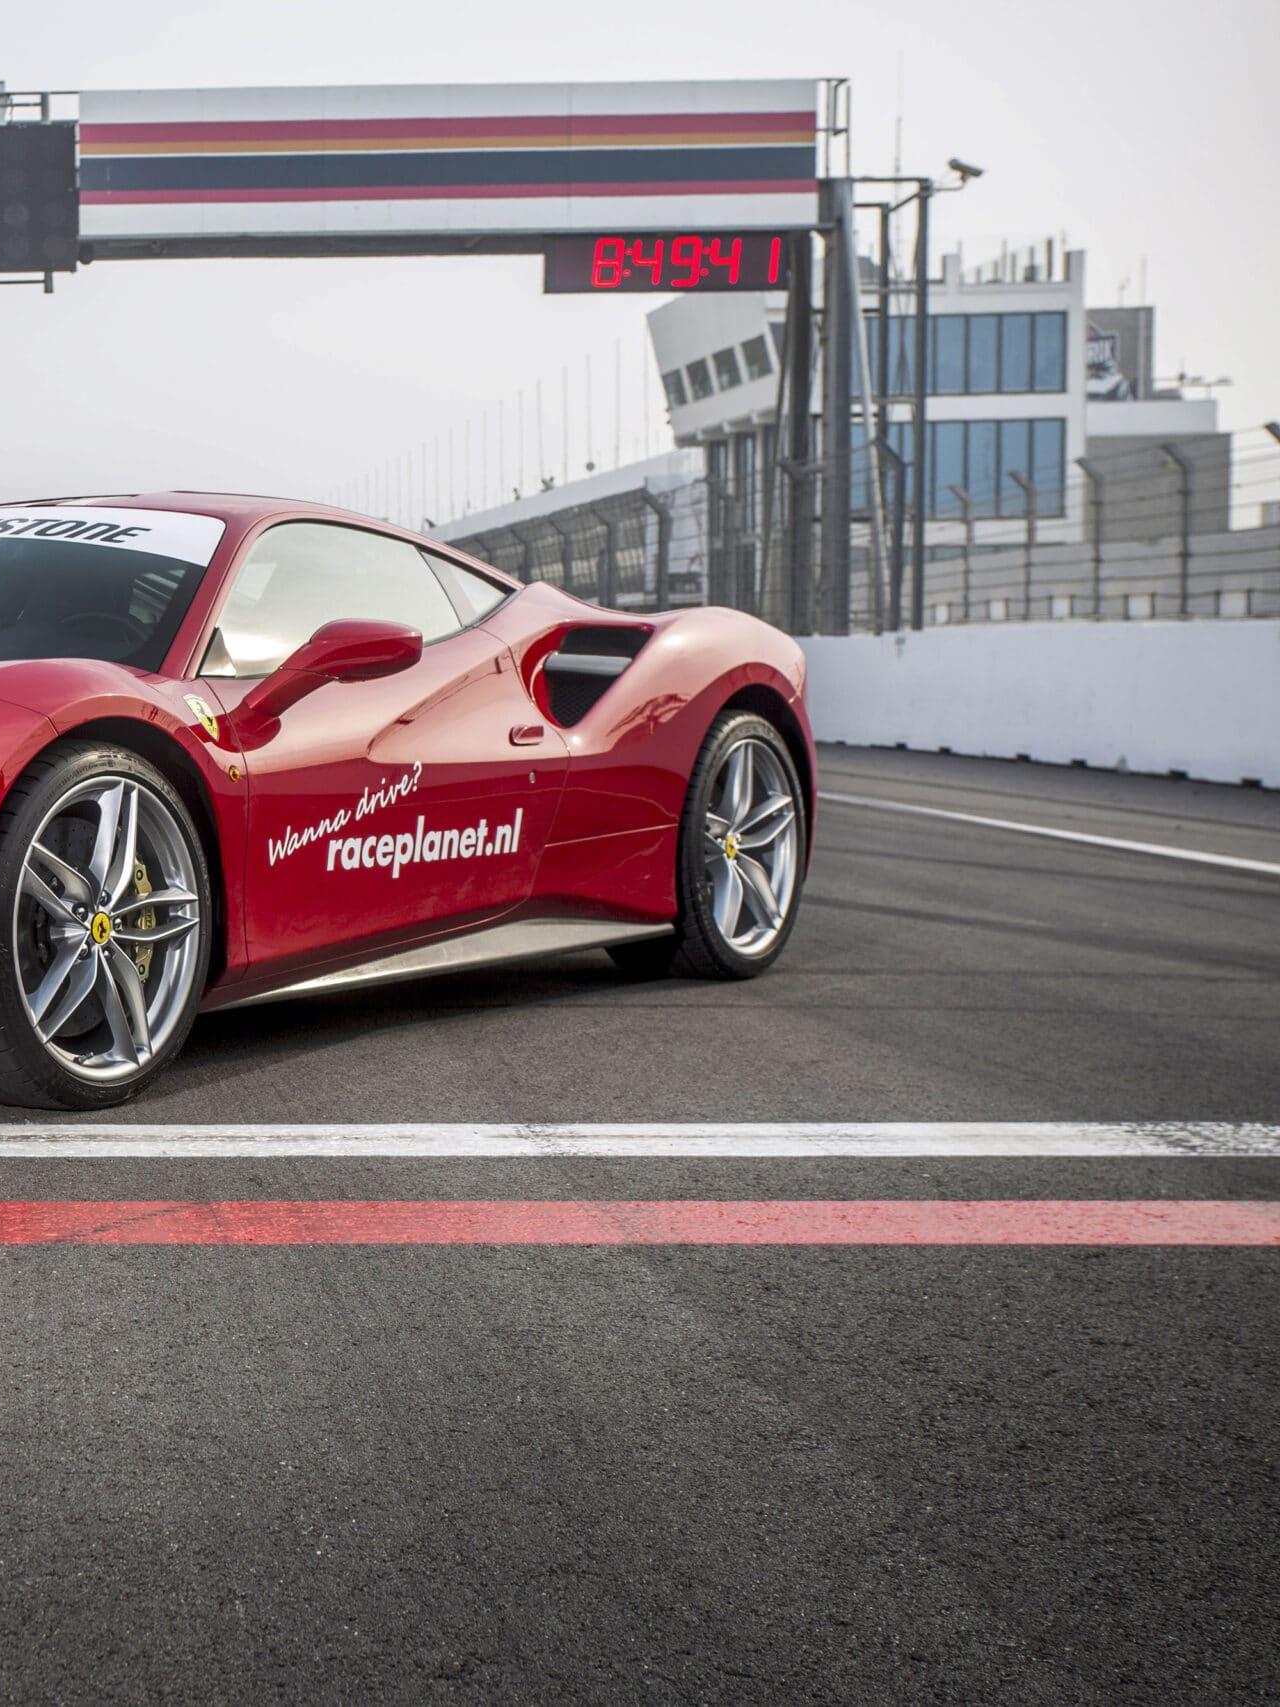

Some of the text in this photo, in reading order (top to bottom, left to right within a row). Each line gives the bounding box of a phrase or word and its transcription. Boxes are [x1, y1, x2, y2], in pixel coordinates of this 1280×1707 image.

[591, 236, 782, 288] 8:49:41
[268, 760, 423, 867] Wanna drive?
[326, 808, 524, 879] raceplanet.nl
